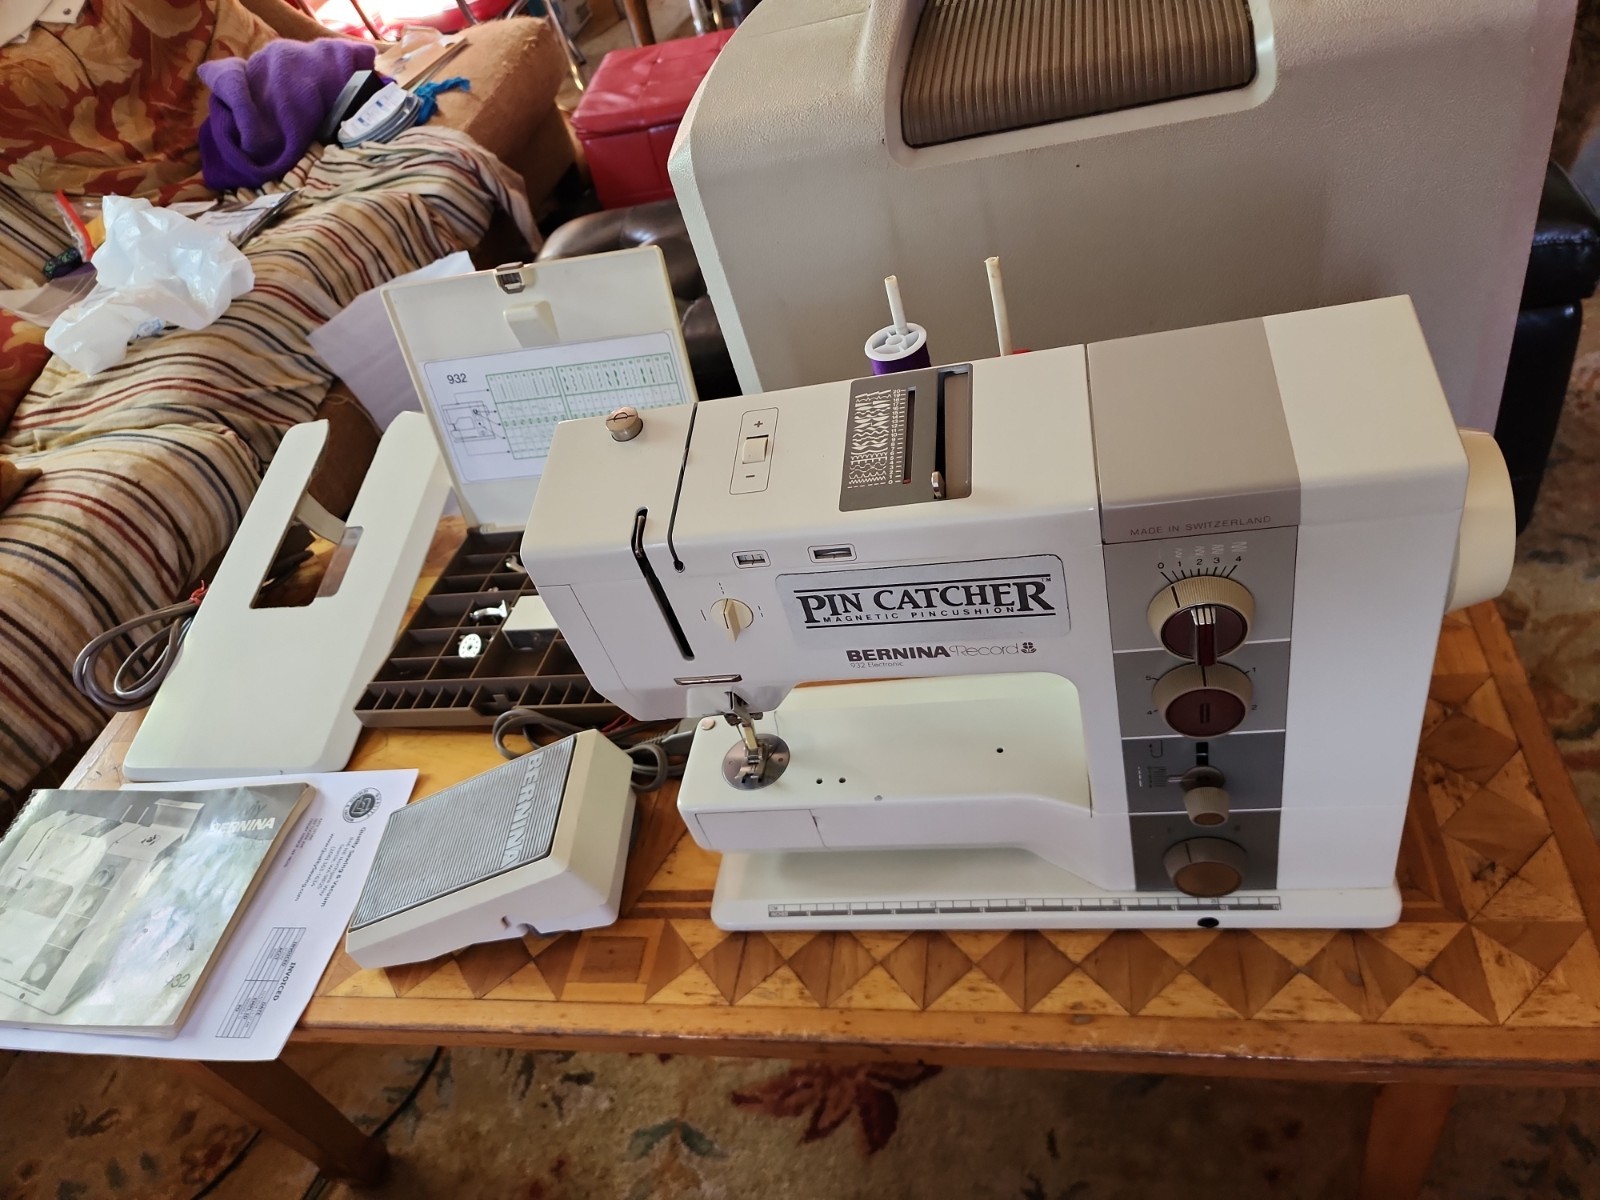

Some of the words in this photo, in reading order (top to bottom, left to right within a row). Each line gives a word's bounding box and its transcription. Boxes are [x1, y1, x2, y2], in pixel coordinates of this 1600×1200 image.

[447, 373, 467, 384] 932
[1130, 526, 1162, 536] MADE
[1185, 515, 1271, 531] SWITZERLAND
[796, 592, 863, 623] PIN
[873, 581, 1055, 611] CATCHER
[823, 612, 898, 623] MAGNETIC
[910, 606, 1015, 618] PINCUSHION
[846, 645, 951, 662] BERNINA
[950, 642, 1019, 657] Record
[500, 756, 543, 869] BERNINA
[273, 962, 296, 1001] INVOICED
